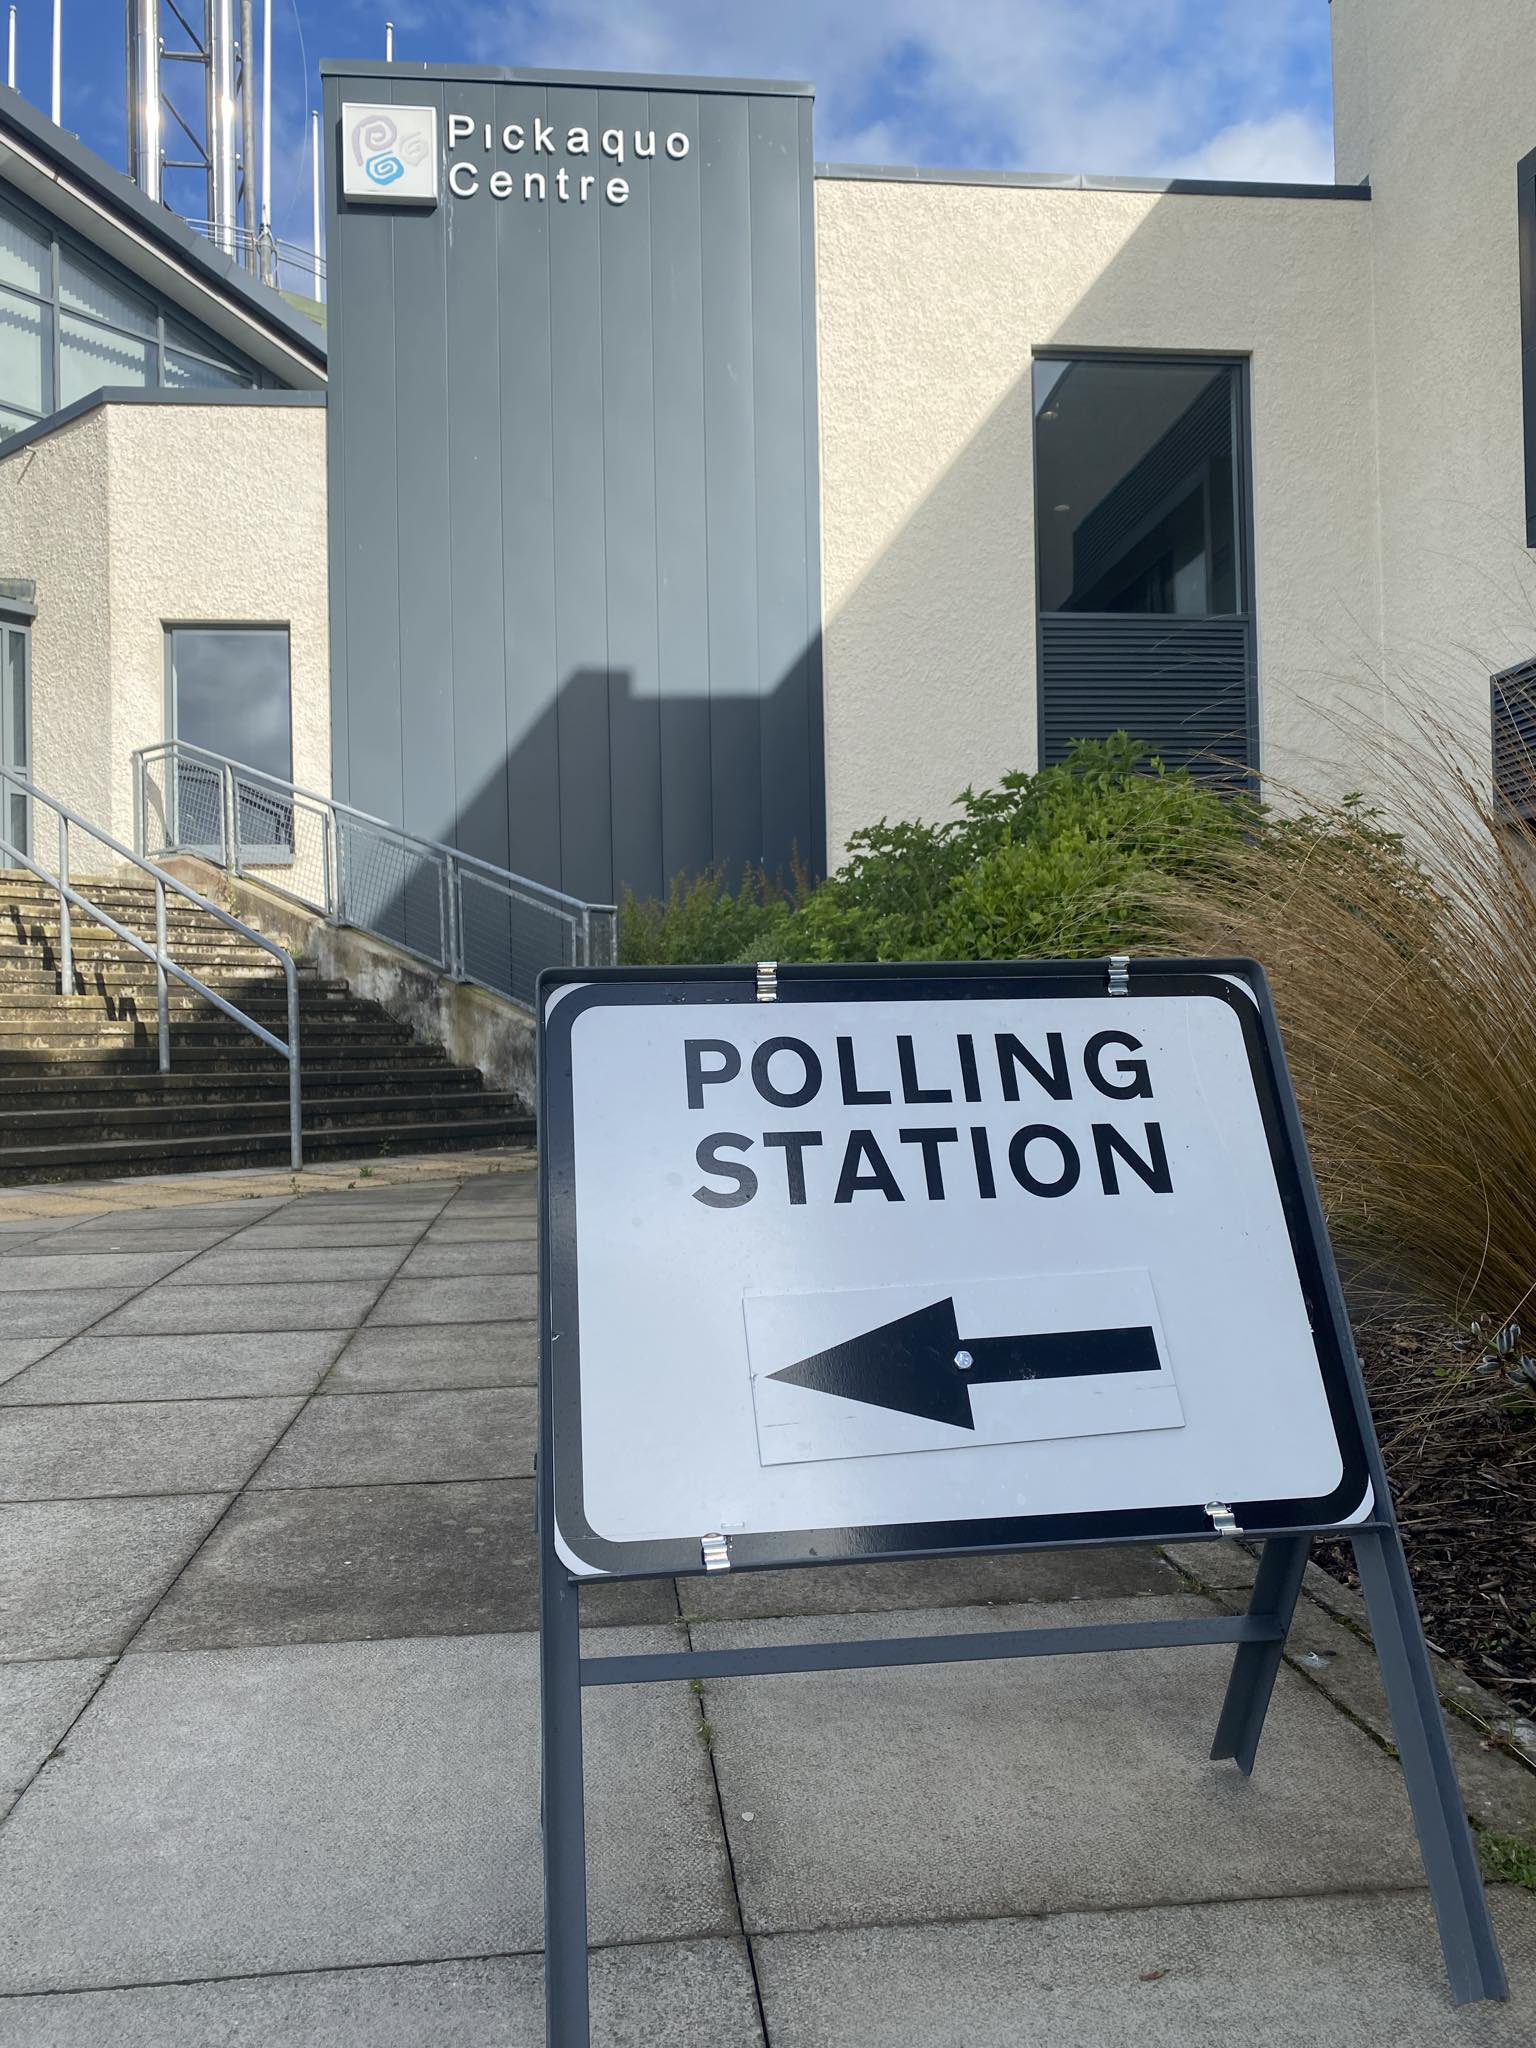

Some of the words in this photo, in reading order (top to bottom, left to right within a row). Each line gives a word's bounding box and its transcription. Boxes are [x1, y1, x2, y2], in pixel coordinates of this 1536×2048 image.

[449, 161, 631, 204] Centre
[684, 1029, 1154, 1110] POLLING
[692, 1122, 1174, 1209] STATION
